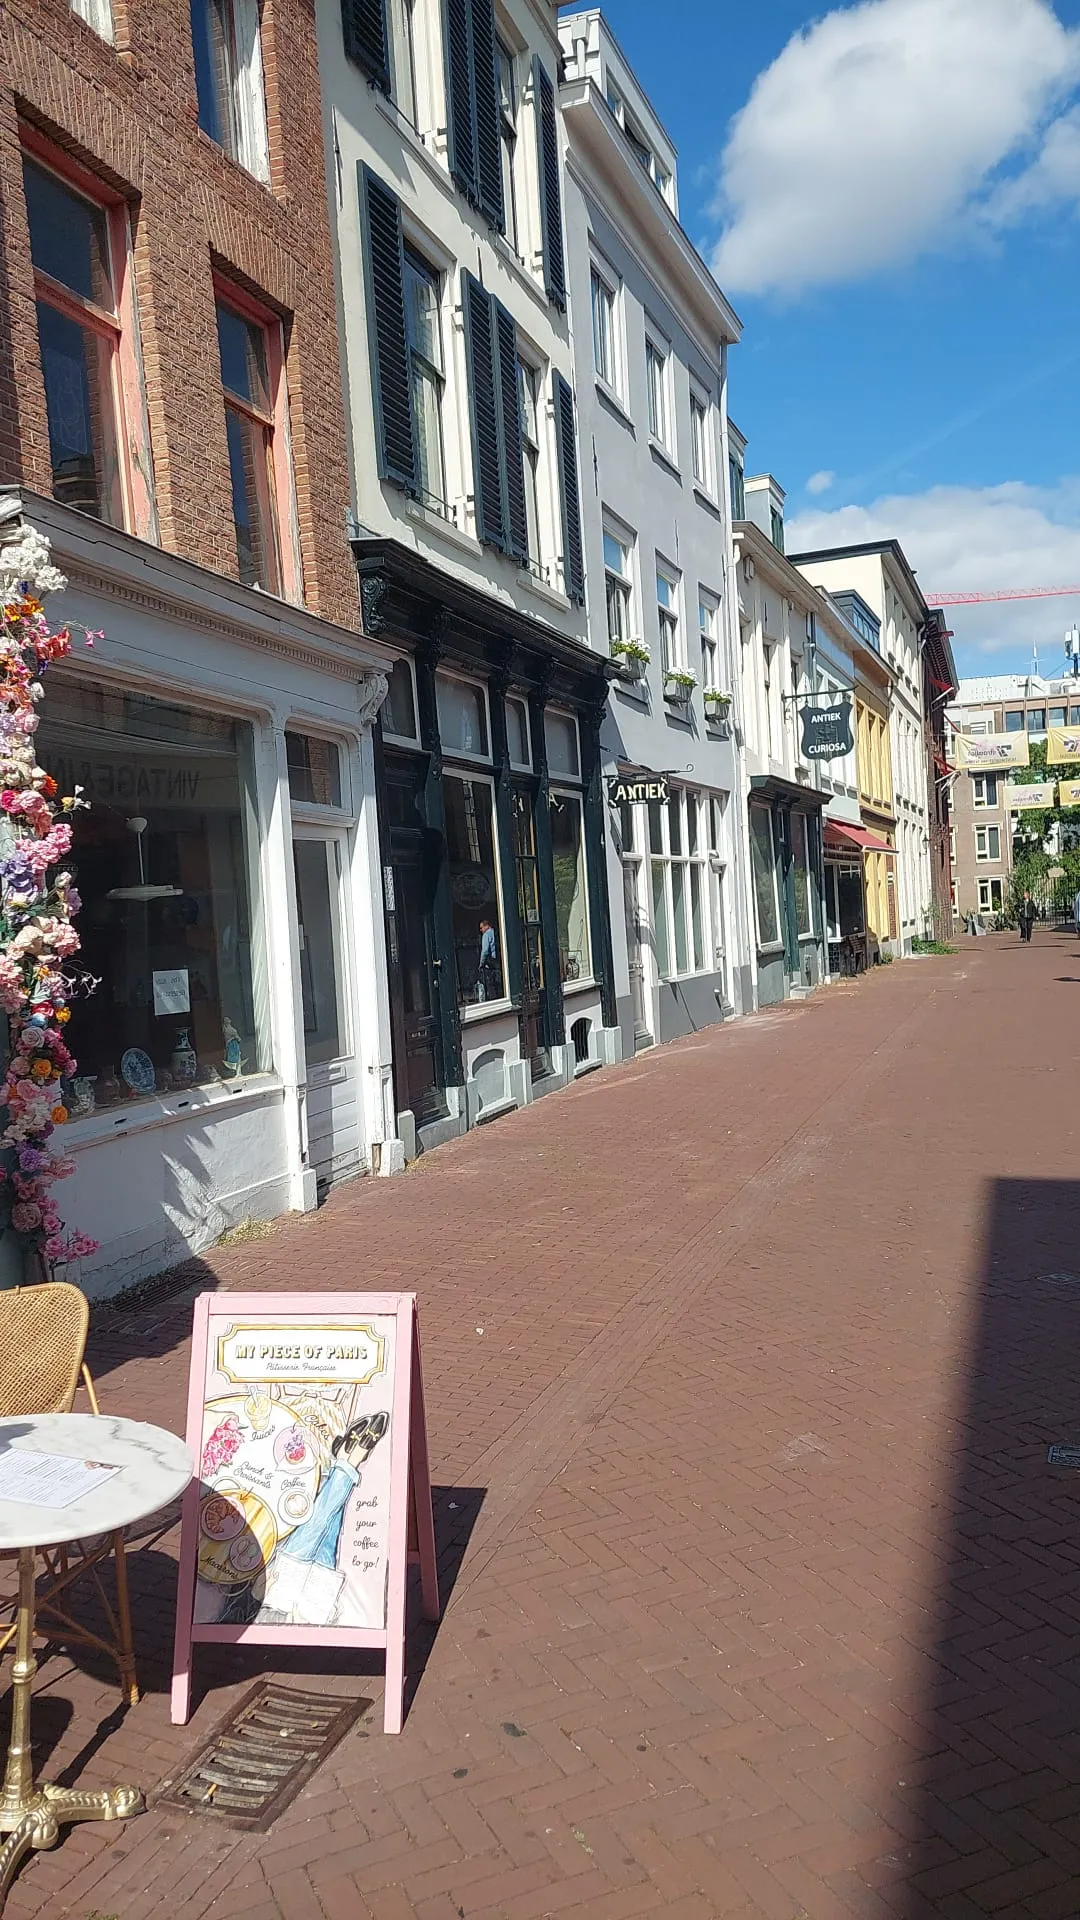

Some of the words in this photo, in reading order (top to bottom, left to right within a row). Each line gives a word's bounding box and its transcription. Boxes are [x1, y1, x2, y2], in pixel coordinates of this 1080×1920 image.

[811, 712, 841, 724] ANTIEK
[808, 742, 847, 754] CURIOSA
[614, 783, 667, 801] ANTIEK
[235, 1345, 255, 1359] MY
[260, 1345, 301, 1359] PIECE
[304, 1345, 323, 1359] OF
[326, 1345, 368, 1359] PARIS
[304, 1414, 331, 1441] Cakes
[281, 1477, 307, 1491] Coffee
[355, 1496, 378, 1512] grab
[355, 1520, 377, 1532] your
[353, 1536, 380, 1550] coffee
[200, 1555, 239, 1580] Macarons
[363, 1557, 380, 1572] go!
